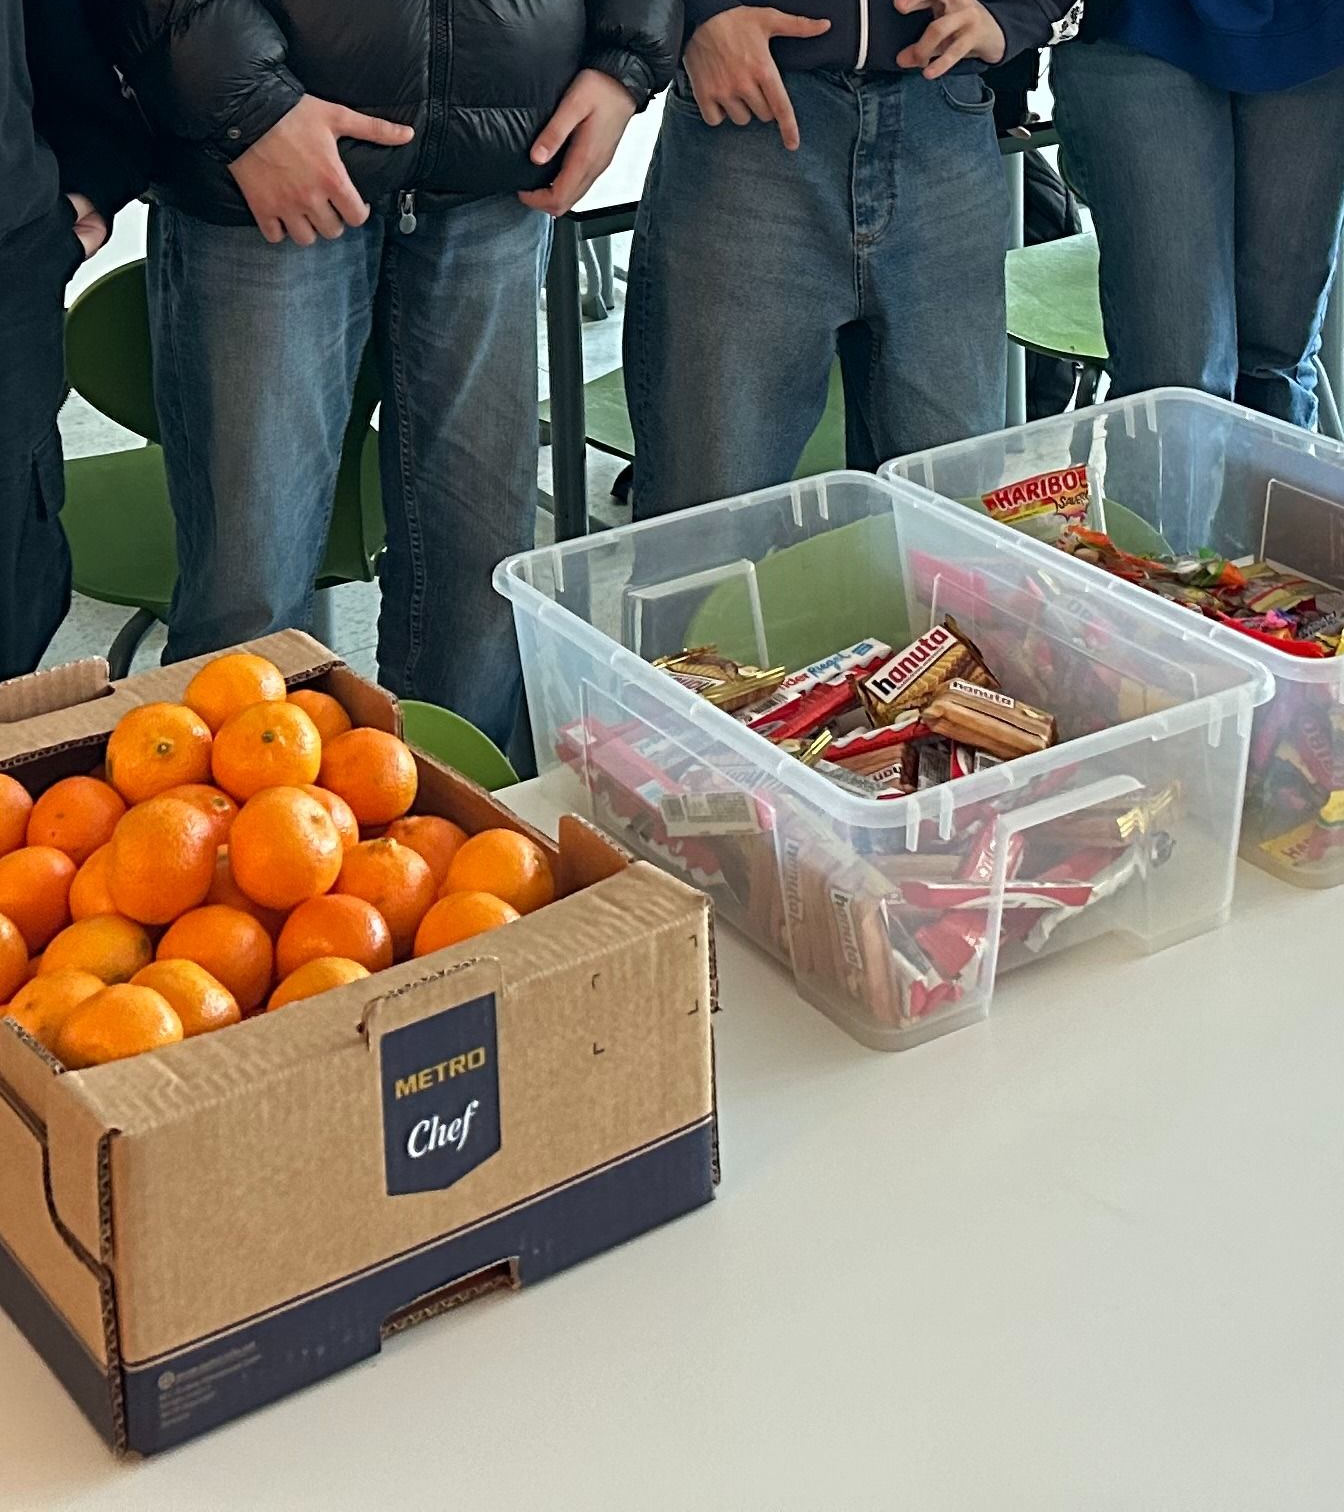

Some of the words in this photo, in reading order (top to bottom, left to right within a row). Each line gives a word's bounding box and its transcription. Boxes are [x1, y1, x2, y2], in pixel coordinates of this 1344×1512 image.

[994, 470, 1080, 510] HARIBO
[870, 626, 949, 697] hanuta
[394, 1046, 486, 1100] METRO
[407, 1099, 479, 1158] Chef
